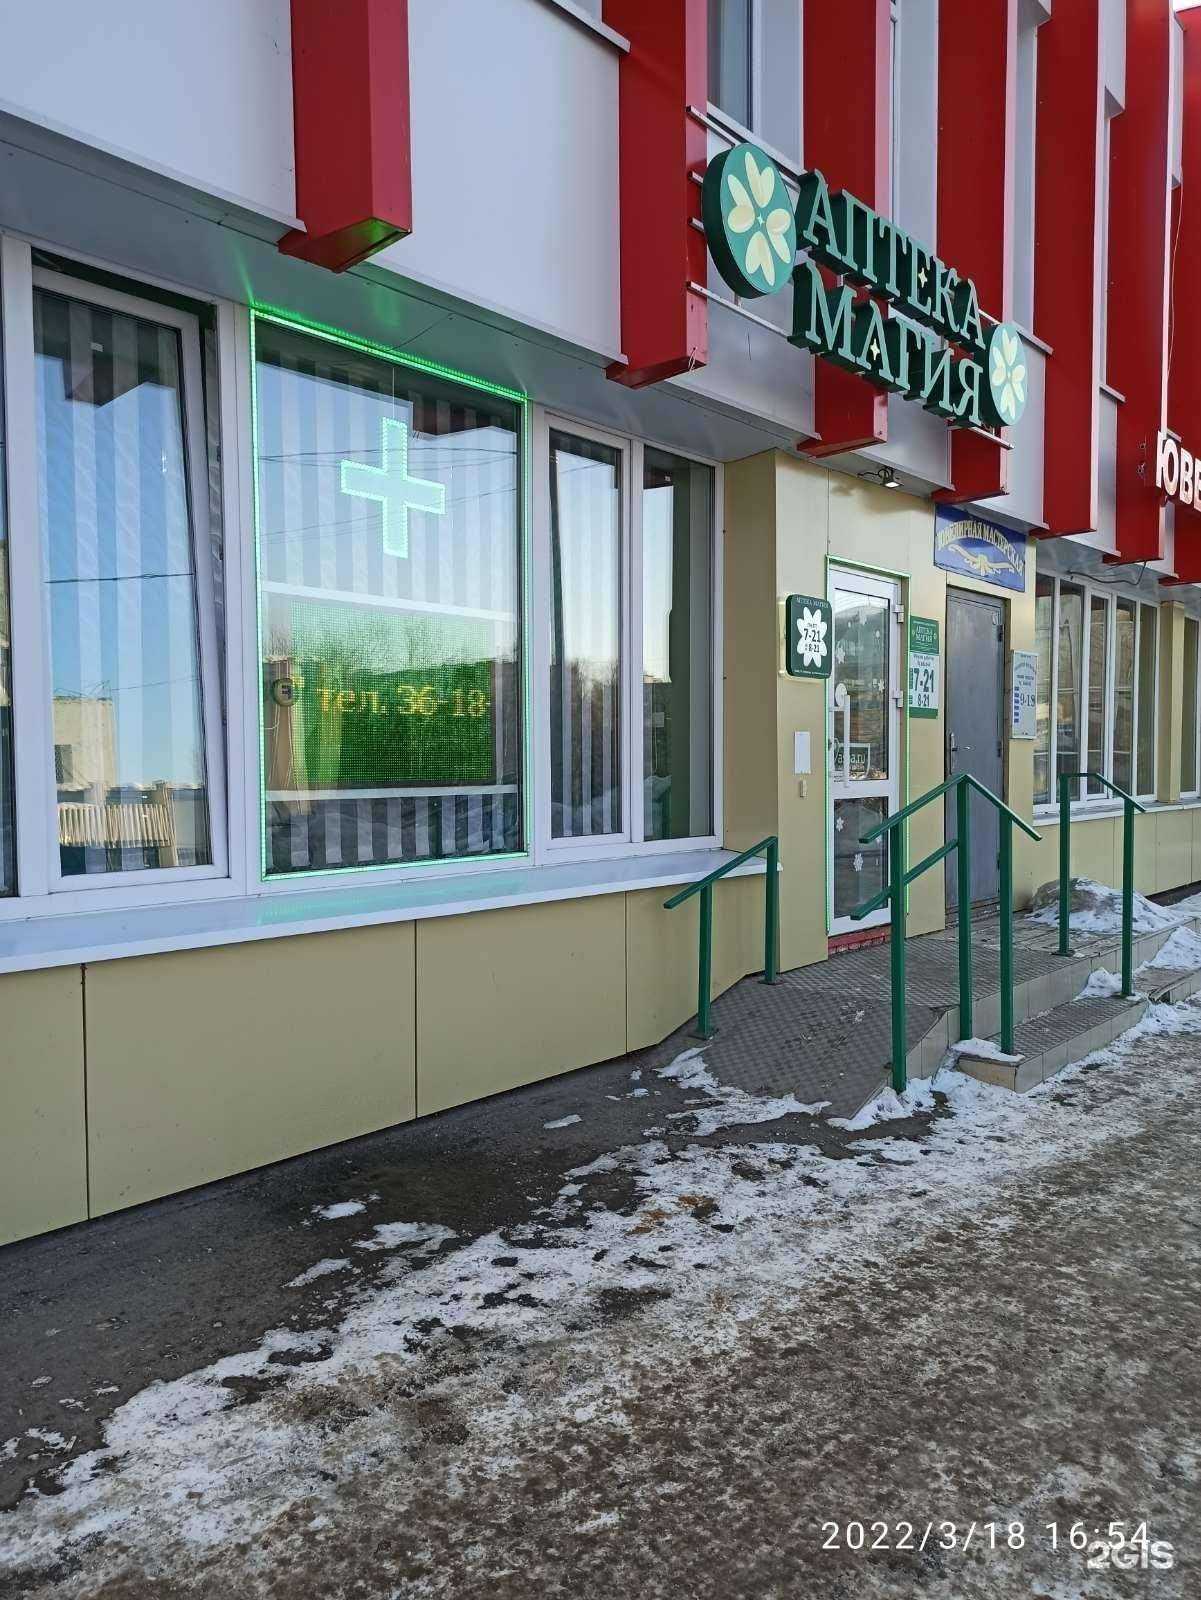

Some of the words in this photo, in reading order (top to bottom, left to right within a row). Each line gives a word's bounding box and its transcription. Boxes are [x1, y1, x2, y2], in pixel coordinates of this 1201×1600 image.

[799, 167, 987, 350] АПТЕКА
[804, 260, 984, 428] МАГИЯ
[1155, 430, 1201, 513] ЮВЕ
[803, 628, 821, 642] 7-21
[914, 667, 934, 693] 7-21
